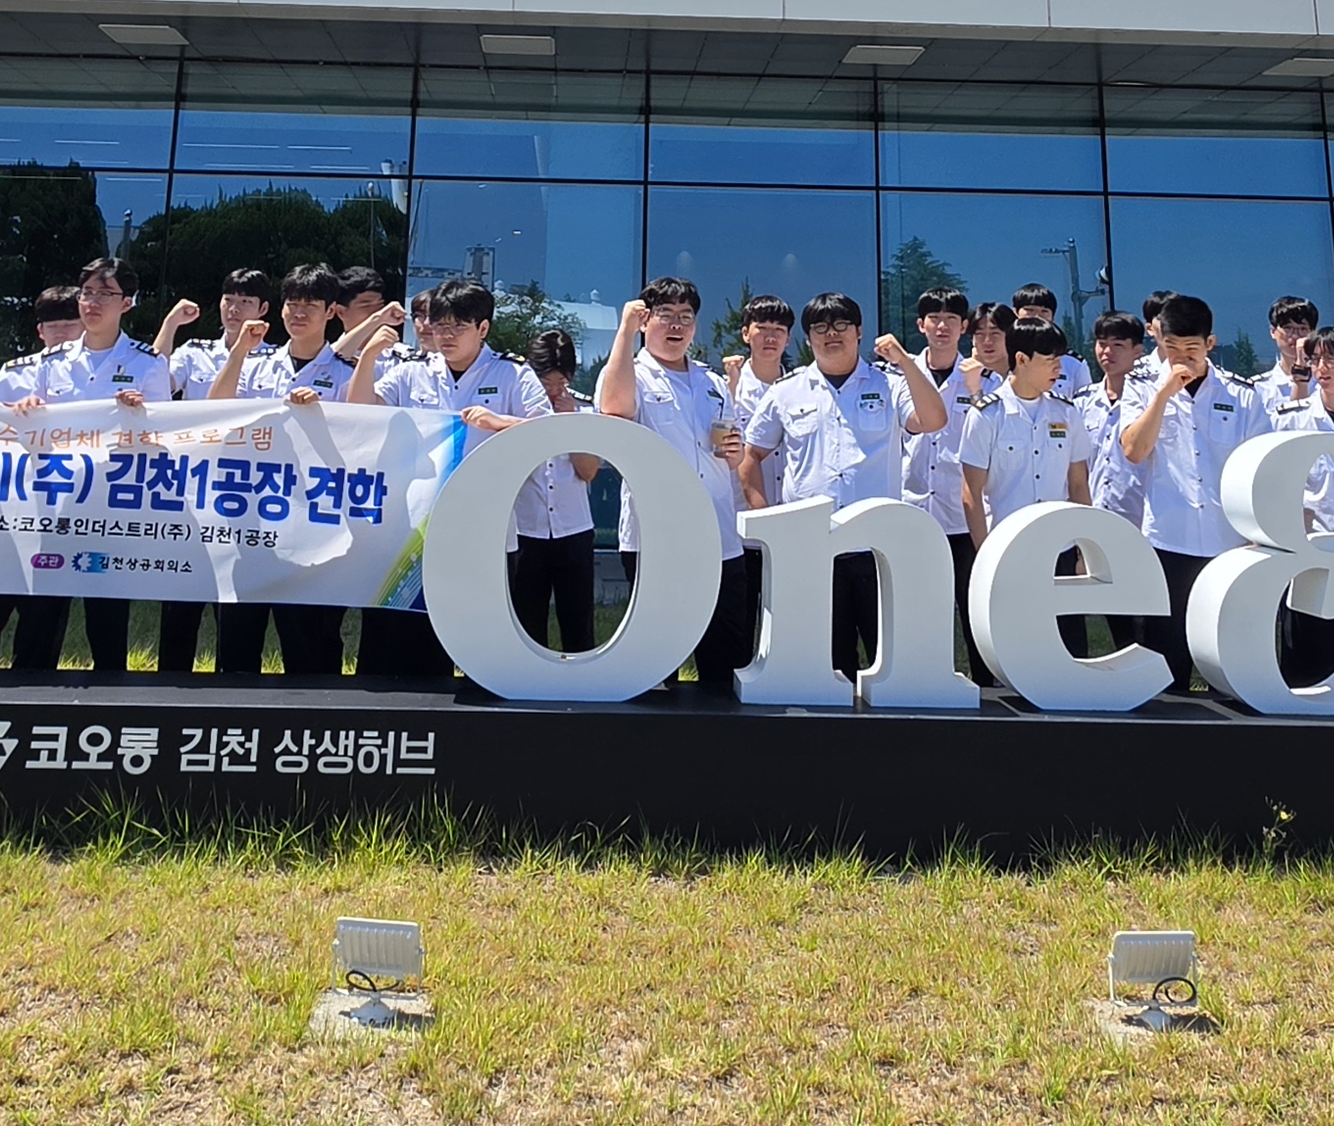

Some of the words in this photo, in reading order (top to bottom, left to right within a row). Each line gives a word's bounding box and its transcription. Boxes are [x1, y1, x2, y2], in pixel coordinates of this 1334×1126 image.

[110, 428, 163, 449] 견학
[173, 426, 274, 452] 프로그램
[106, 453, 298, 523] 김천1공장
[305, 466, 388, 525] 견학
[200, 526, 279, 548] 김천1공장
[37, 555, 59, 568] 주관
[99, 556, 193, 573] 김천상공회의소
[25, 725, 160, 775] 코오롱
[179, 727, 260, 773] 김천
[273, 729, 436, 775] 상생허브
